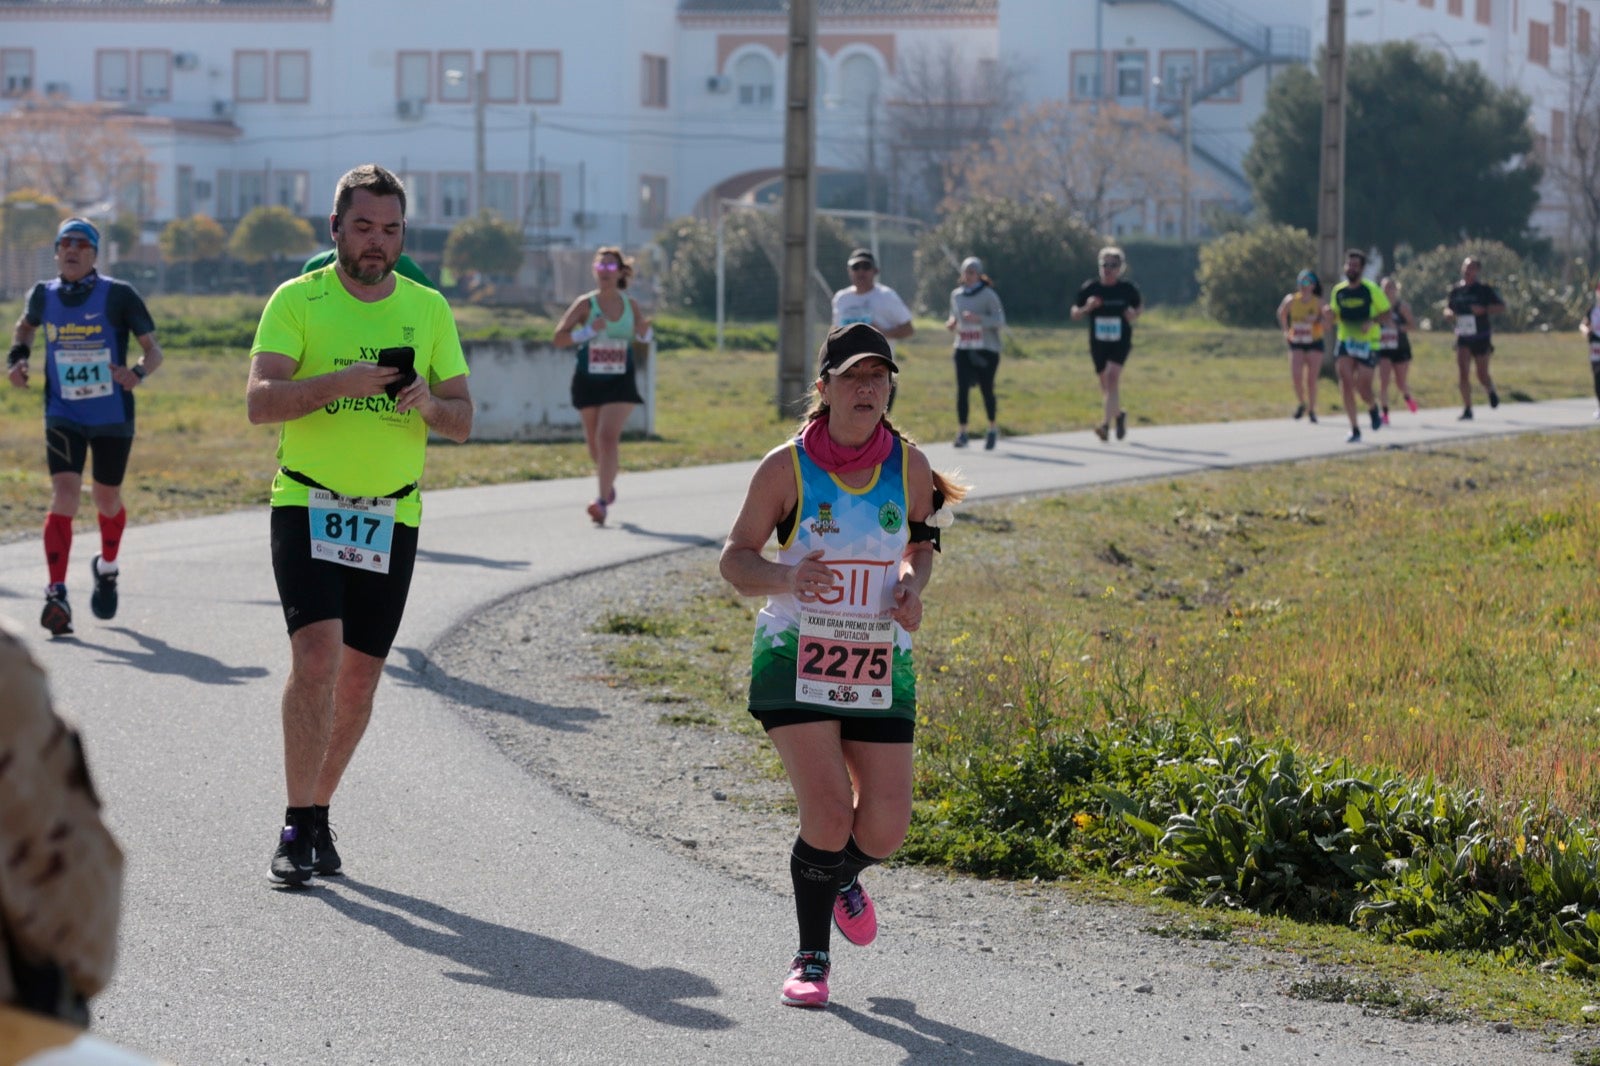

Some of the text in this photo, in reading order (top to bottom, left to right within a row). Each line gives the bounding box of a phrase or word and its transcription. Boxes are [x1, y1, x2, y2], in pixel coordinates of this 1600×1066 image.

[59, 323, 102, 336] olimpo
[65, 365, 101, 383] 441
[343, 397, 411, 416] HEROG
[325, 513, 381, 545] 817
[808, 616, 891, 631] XXXIII GRAN PREMIO DE FONDO
[834, 630, 870, 640] DIPUTACIÓN
[803, 642, 888, 680] 2275
